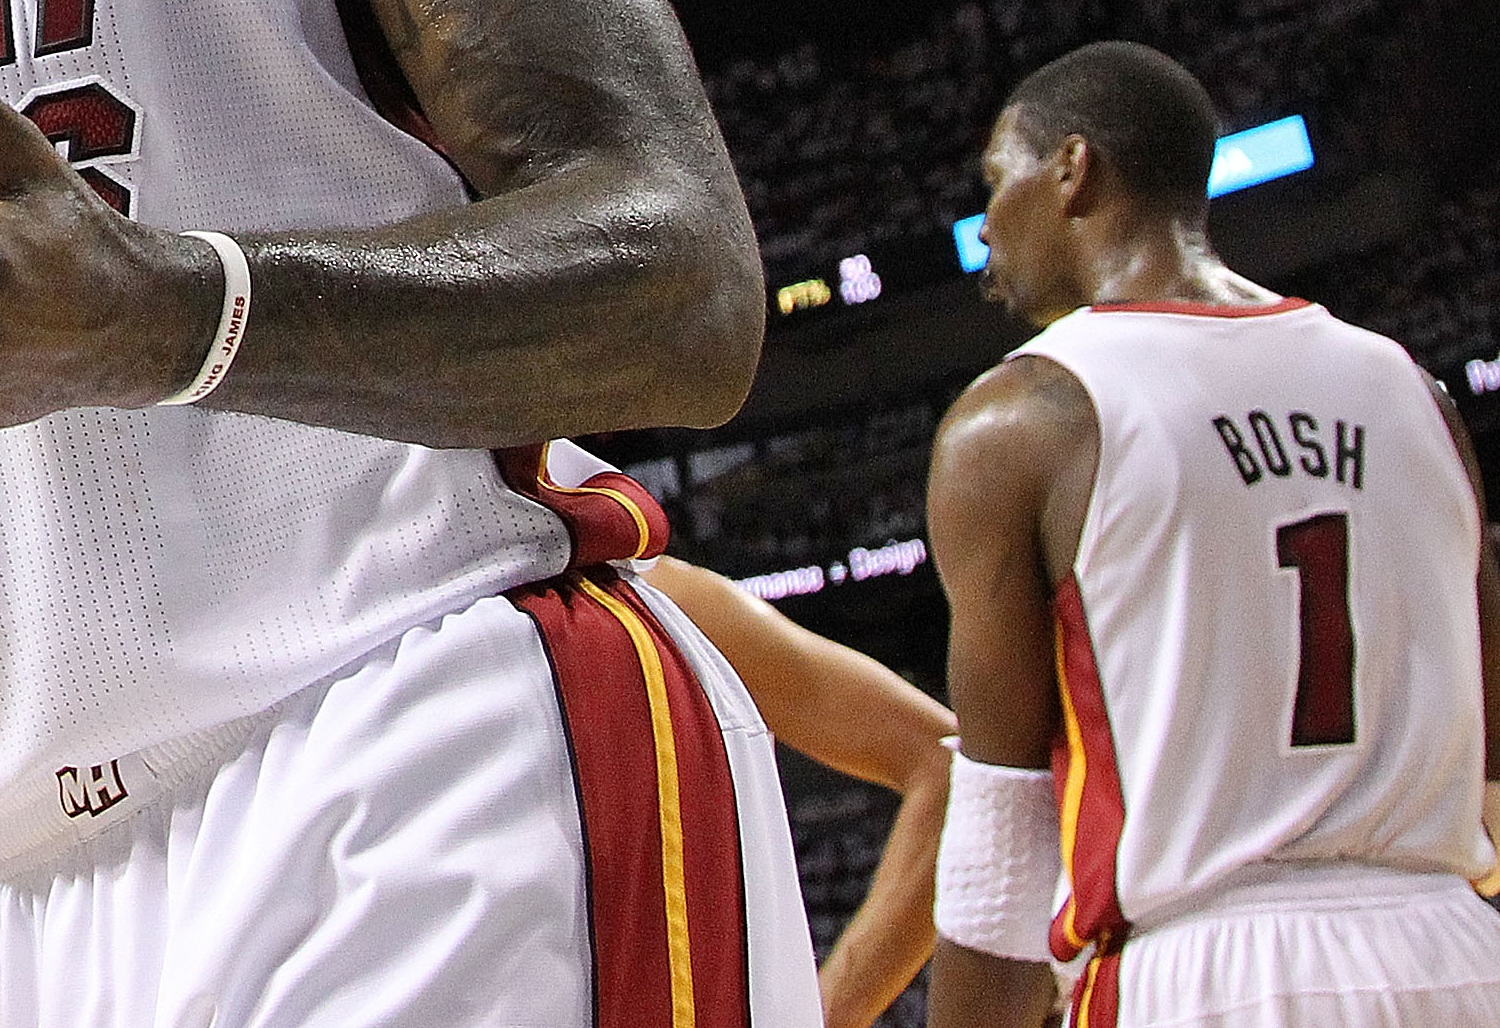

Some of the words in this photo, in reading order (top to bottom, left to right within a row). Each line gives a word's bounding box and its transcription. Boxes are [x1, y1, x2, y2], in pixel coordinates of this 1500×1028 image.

[221, 295, 246, 357] JAMES
[1212, 409, 1367, 490] BOSH
[1276, 511, 1359, 747] 1
